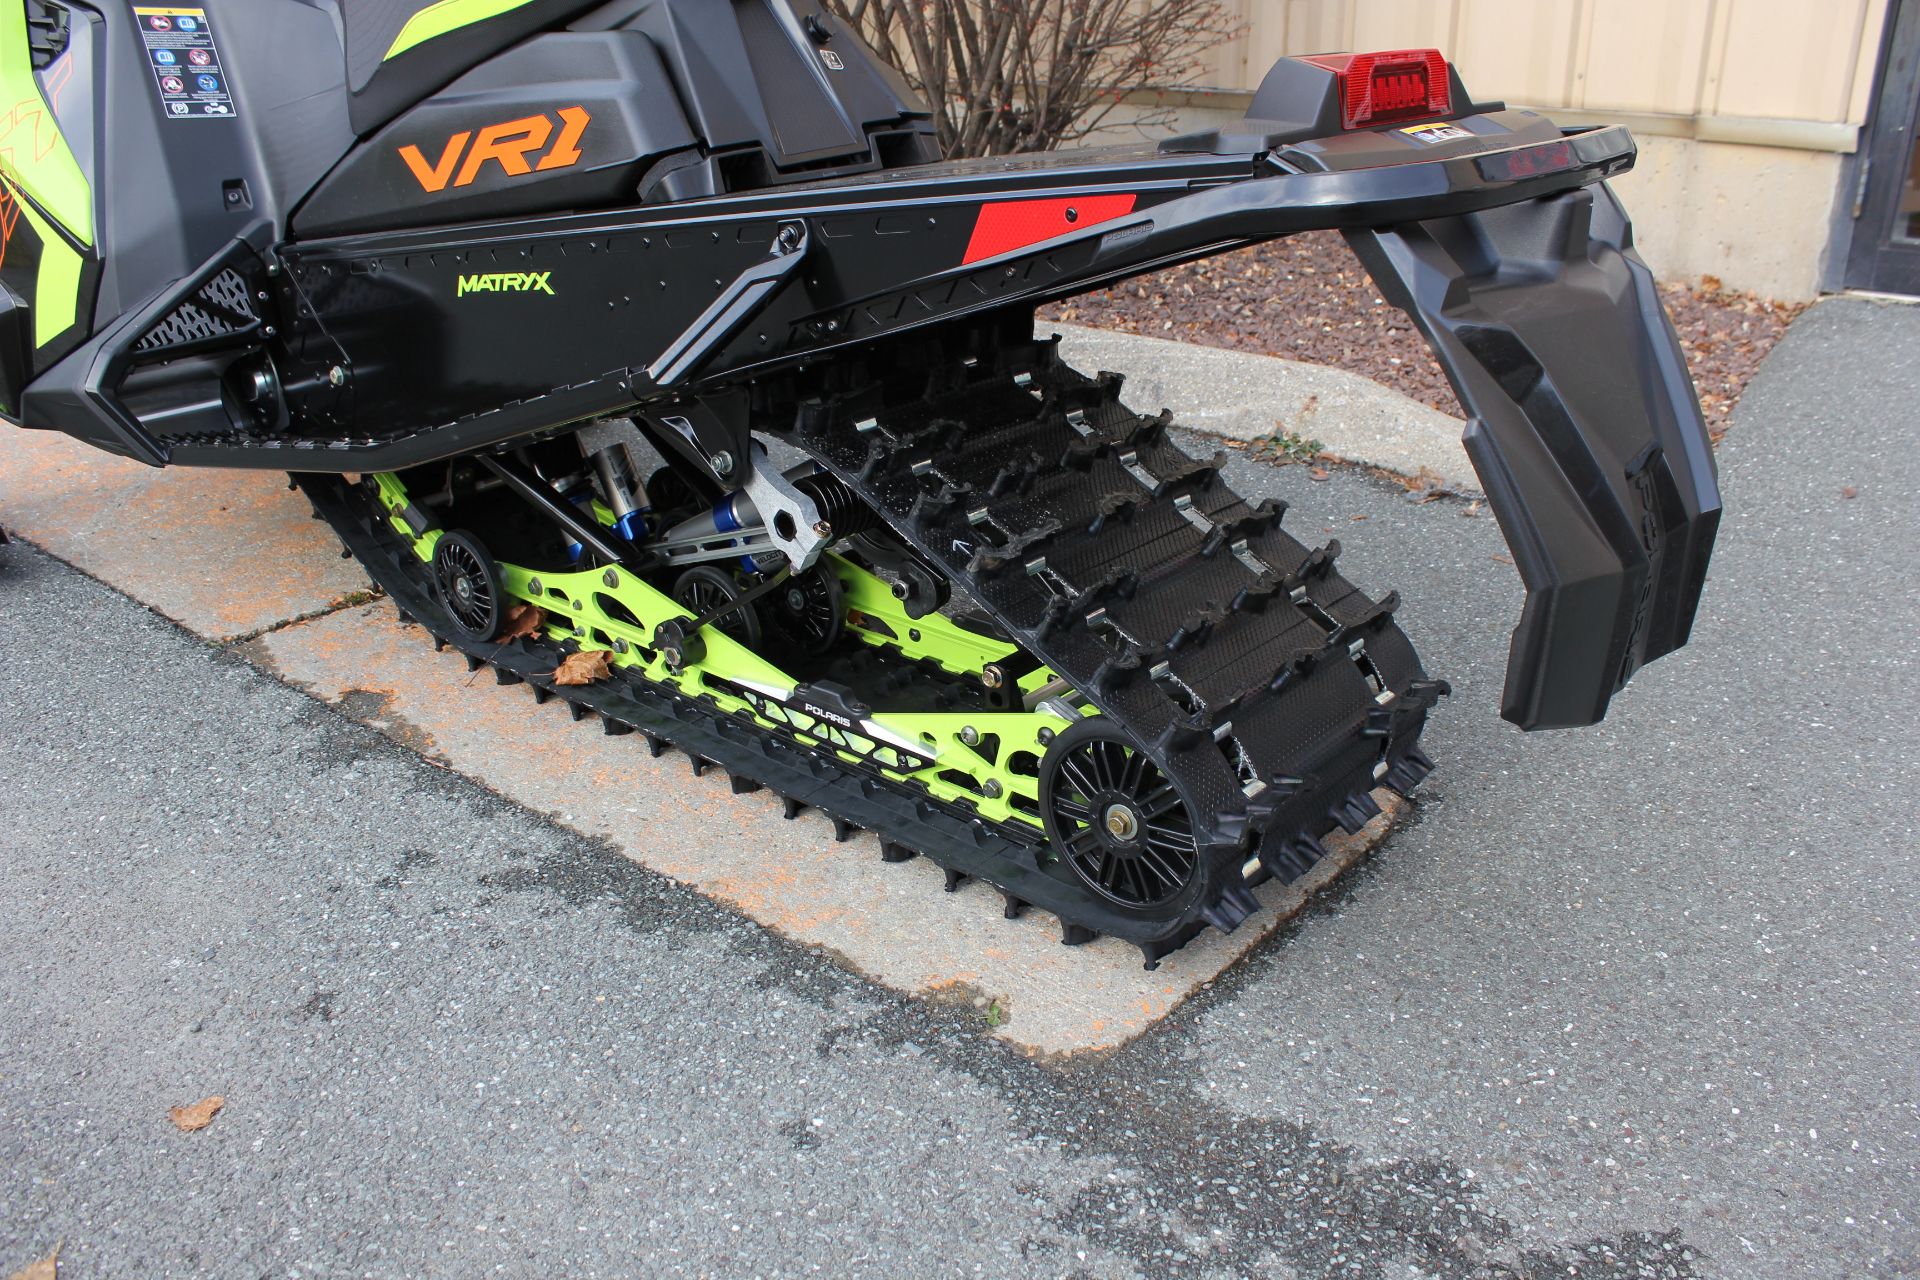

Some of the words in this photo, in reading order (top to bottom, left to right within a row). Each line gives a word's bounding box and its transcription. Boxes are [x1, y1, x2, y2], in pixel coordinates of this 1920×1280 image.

[398, 105, 592, 193] VR1
[457, 271, 556, 298] MATRYX
[806, 703, 851, 728] POLARIS
